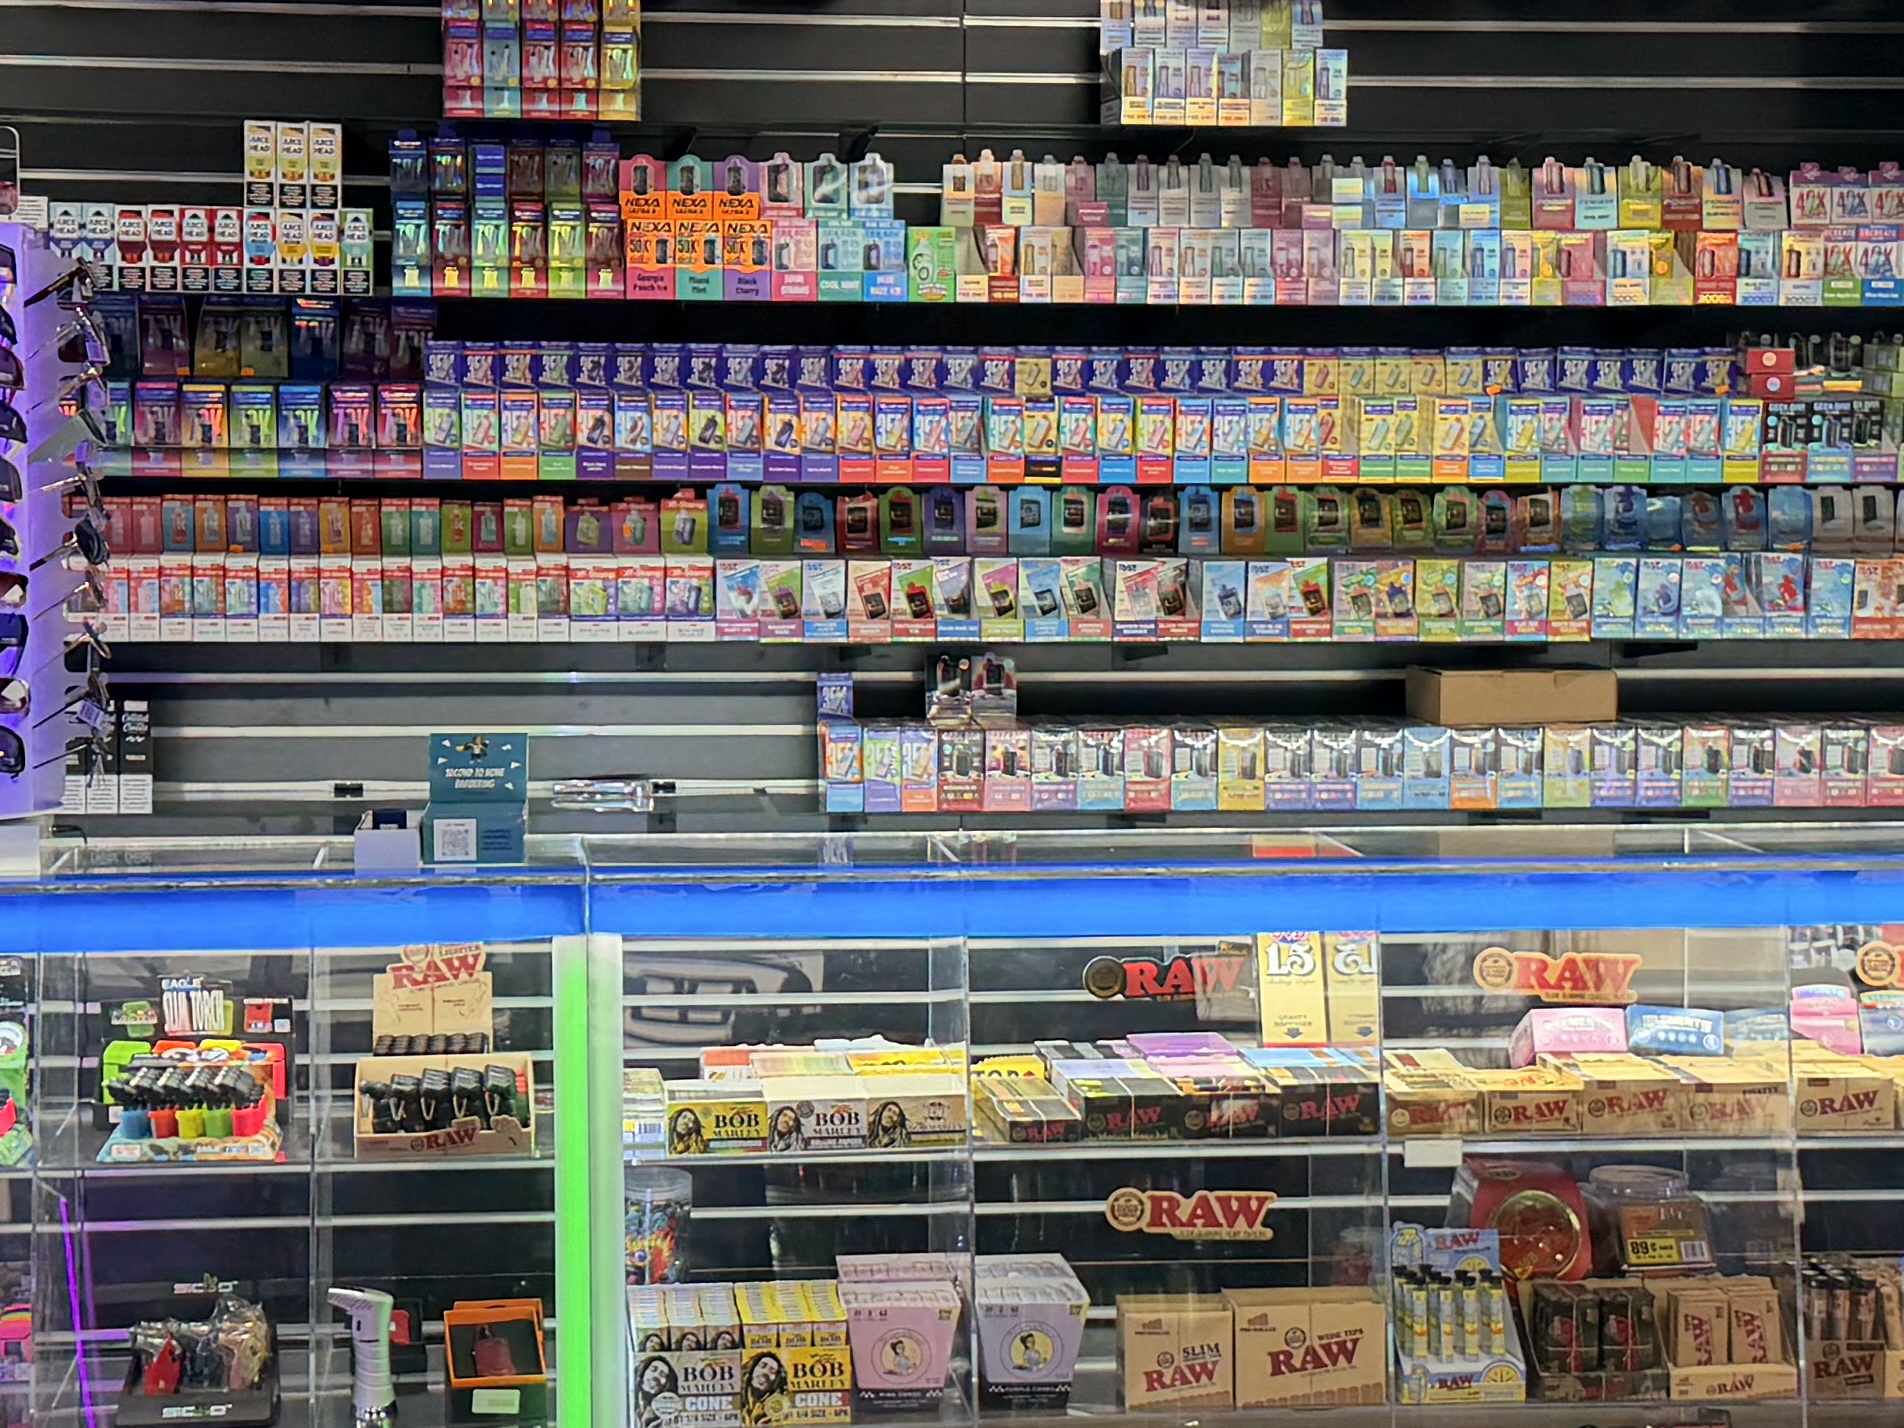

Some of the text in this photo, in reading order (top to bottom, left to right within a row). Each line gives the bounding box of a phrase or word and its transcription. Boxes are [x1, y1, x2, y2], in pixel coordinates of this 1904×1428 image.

[630, 222, 672, 233] NEXA
[392, 953, 482, 989] RAW
[1123, 954, 1247, 997] RAW
[1518, 957, 1630, 992] RAW
[162, 977, 201, 990] EAGLE
[714, 1113, 760, 1129] BOB
[1512, 1099, 1568, 1123] RAW
[425, 1127, 476, 1149] RAW
[1146, 1193, 1271, 1229] RAW
[1182, 1343, 1221, 1359] SLIM
[1267, 1337, 1361, 1377] RAW
[684, 1365, 734, 1382] BOB
[793, 1360, 844, 1378] BOB
[1143, 1360, 1218, 1392] RAW
[1814, 1353, 1875, 1379] RAW
[680, 1383, 735, 1393] MARLEY
[789, 1380, 845, 1390] MARLEY
